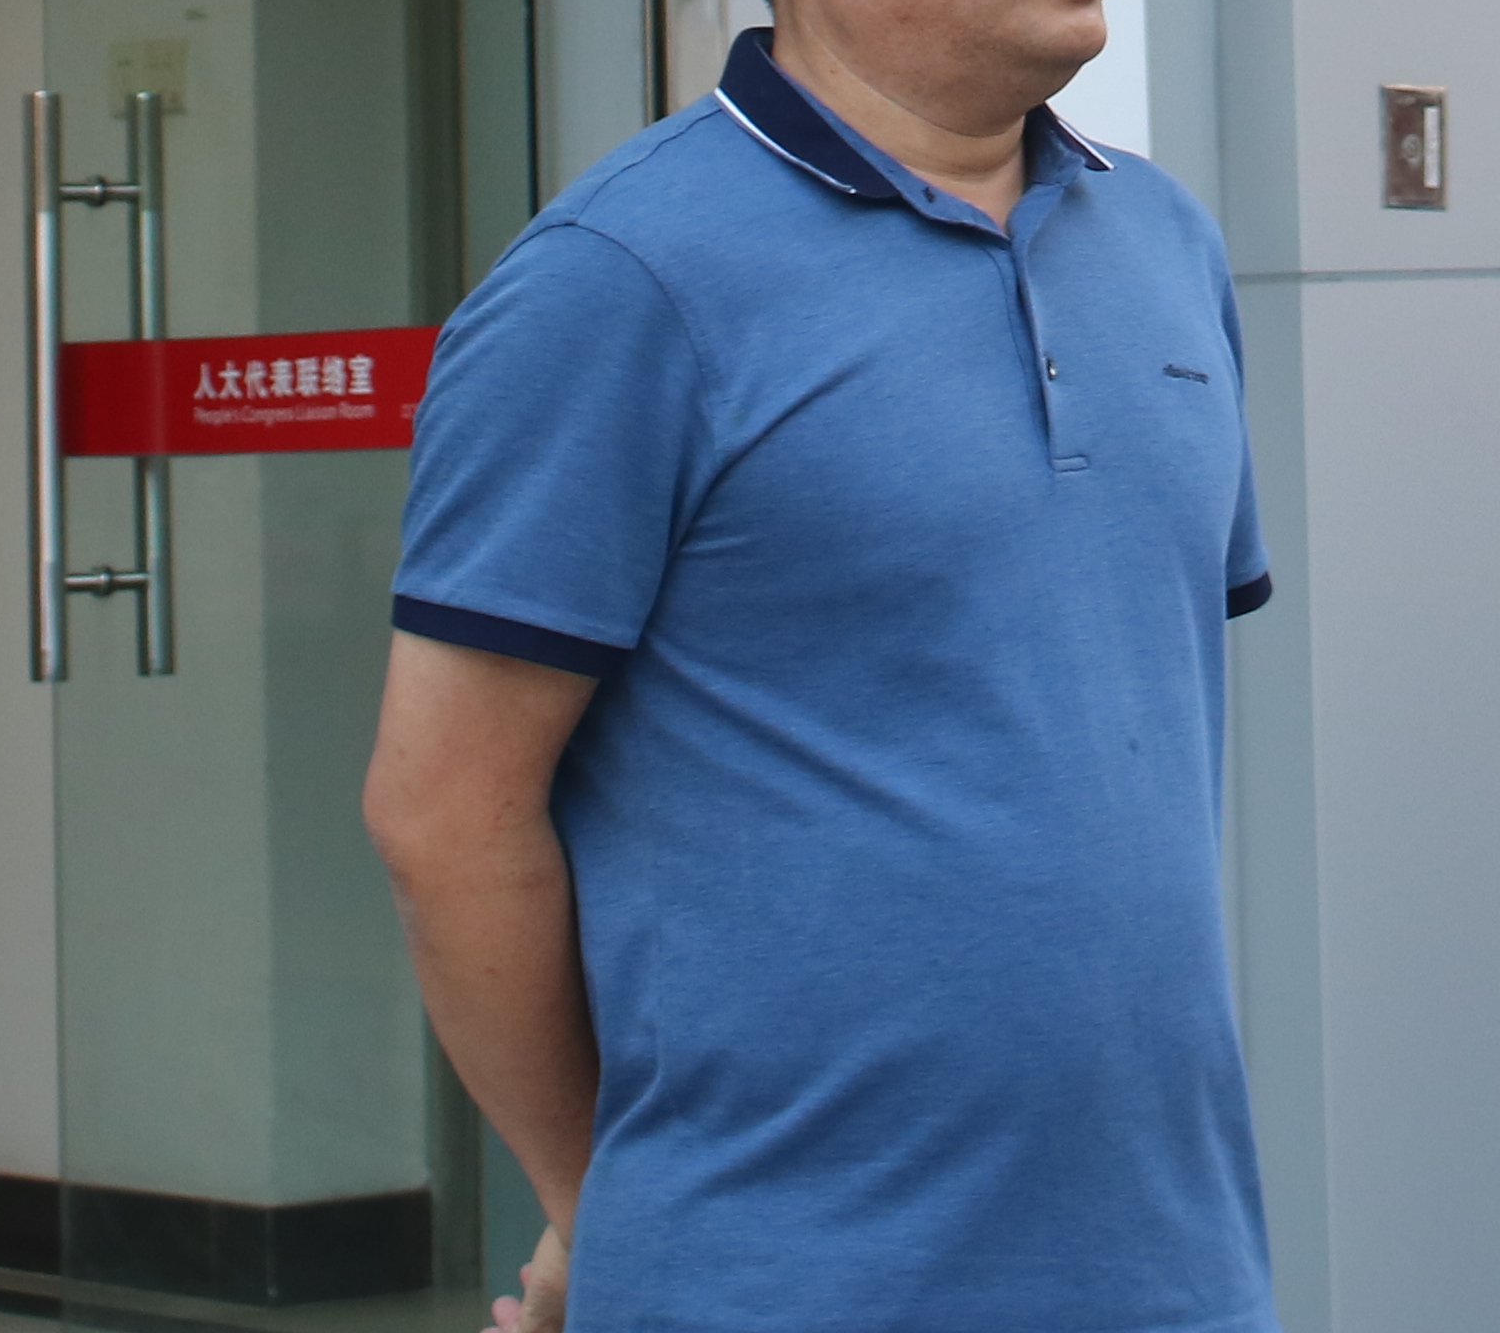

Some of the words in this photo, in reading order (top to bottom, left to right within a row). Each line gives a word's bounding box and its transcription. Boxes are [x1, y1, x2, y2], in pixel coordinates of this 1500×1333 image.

[194, 354, 374, 400] 人大代表联络室
